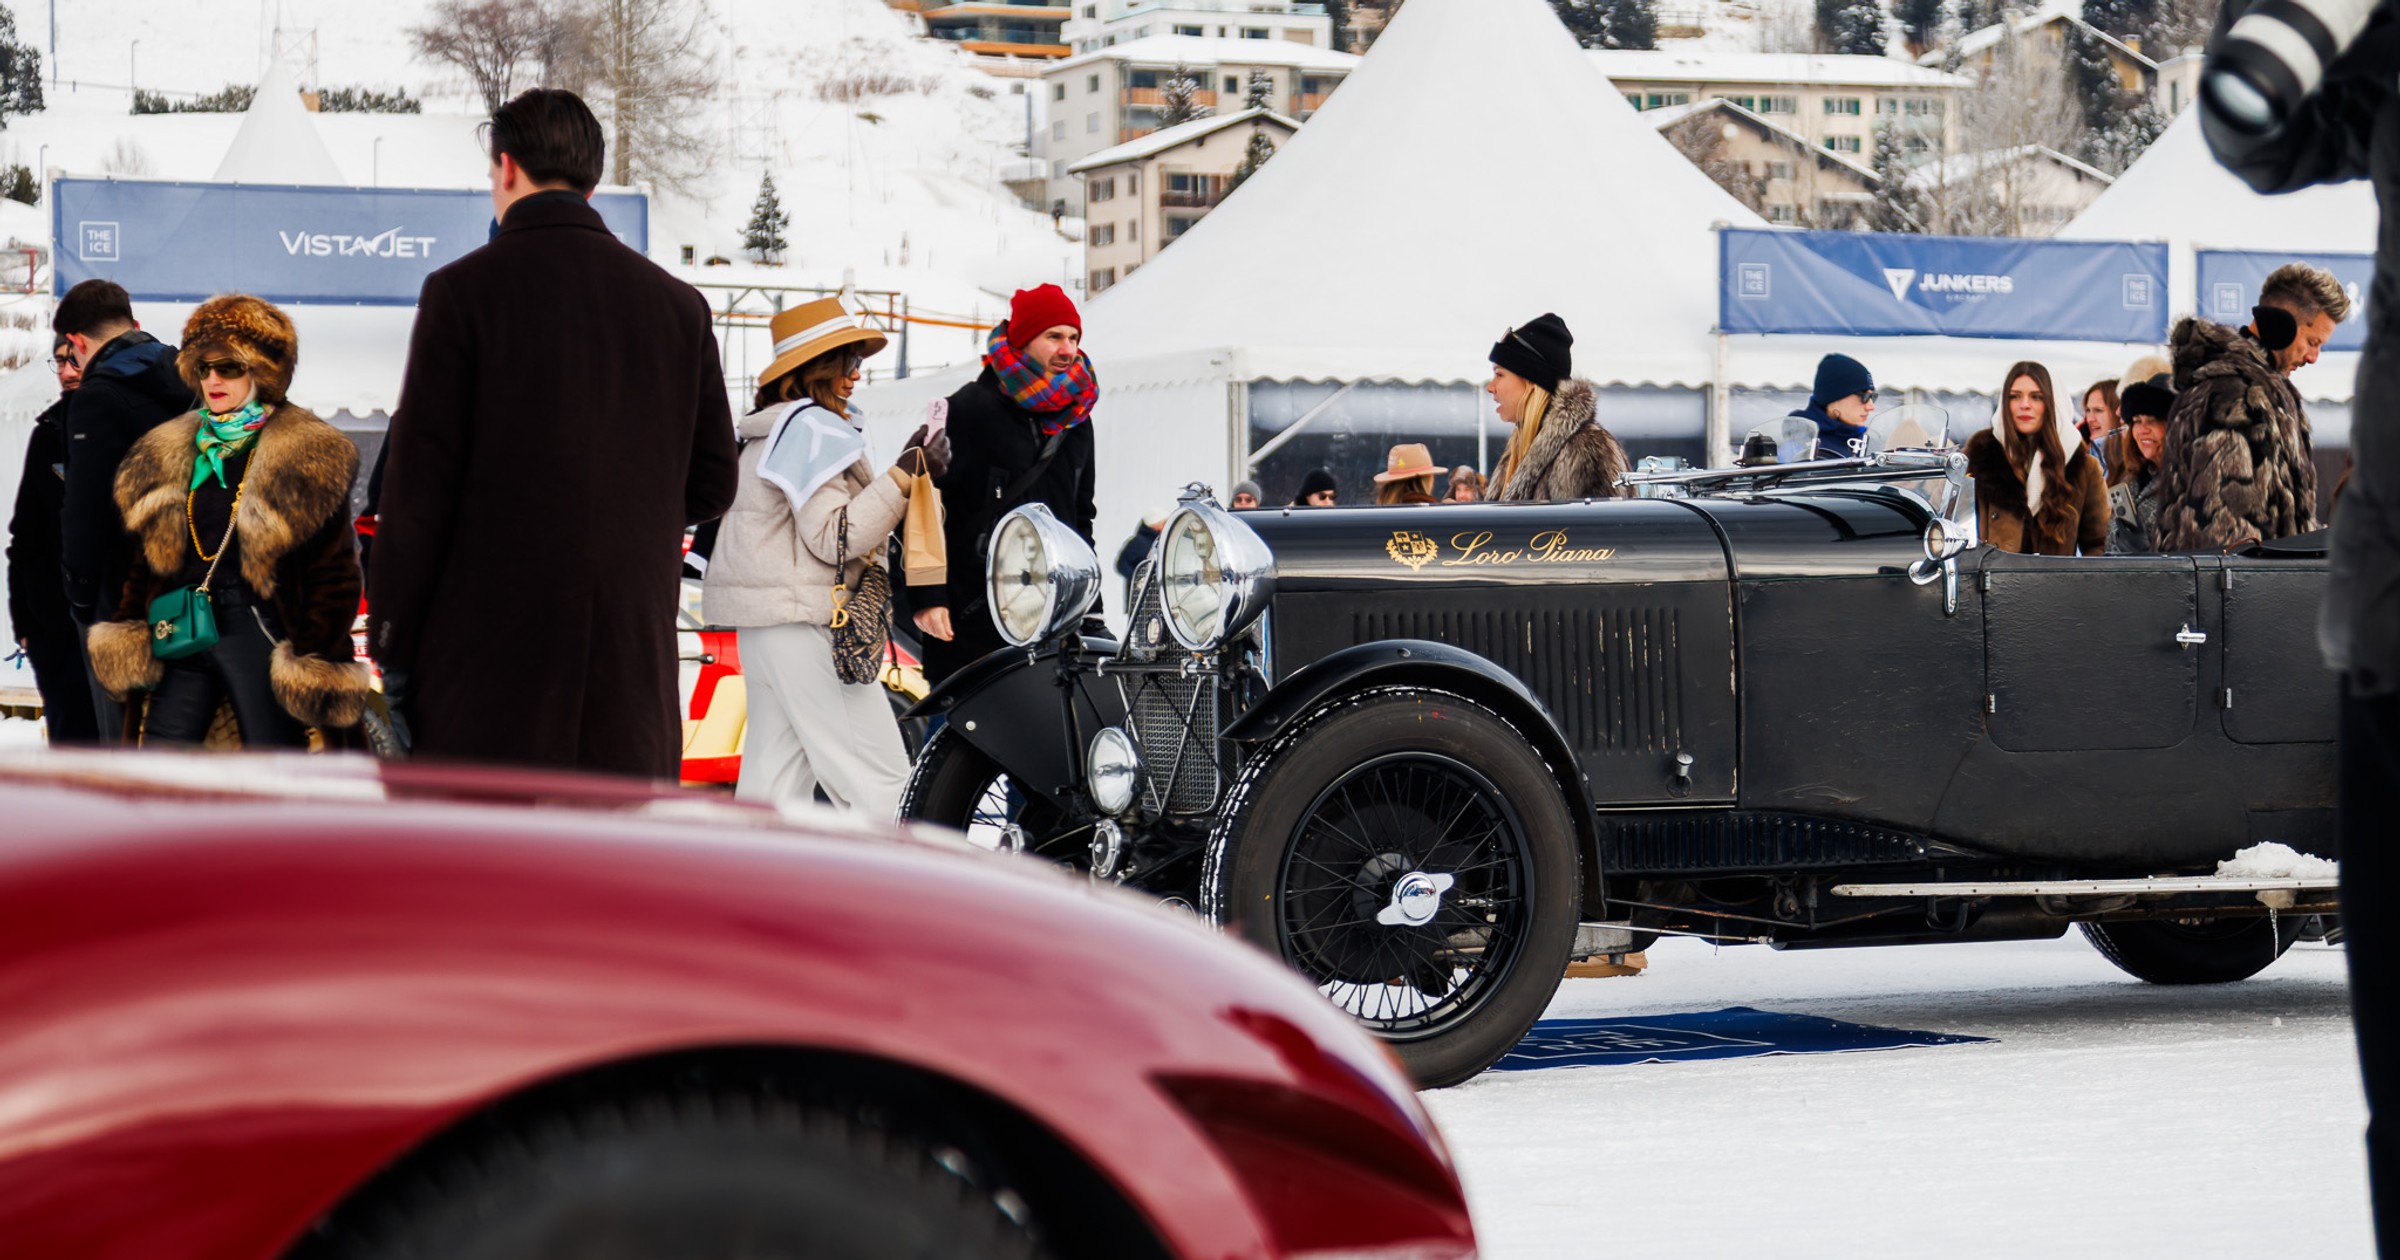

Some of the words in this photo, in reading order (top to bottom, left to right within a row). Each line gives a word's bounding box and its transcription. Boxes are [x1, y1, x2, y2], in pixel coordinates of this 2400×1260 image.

[87, 229, 111, 241] THE
[89, 241, 111, 253] ICE
[1744, 270, 1764, 280] THE
[1745, 280, 1764, 291] ICE
[1919, 273, 2013, 294] JUNKERS
[1442, 531, 1523, 566] Loro
[1527, 527, 1616, 562] Piana
